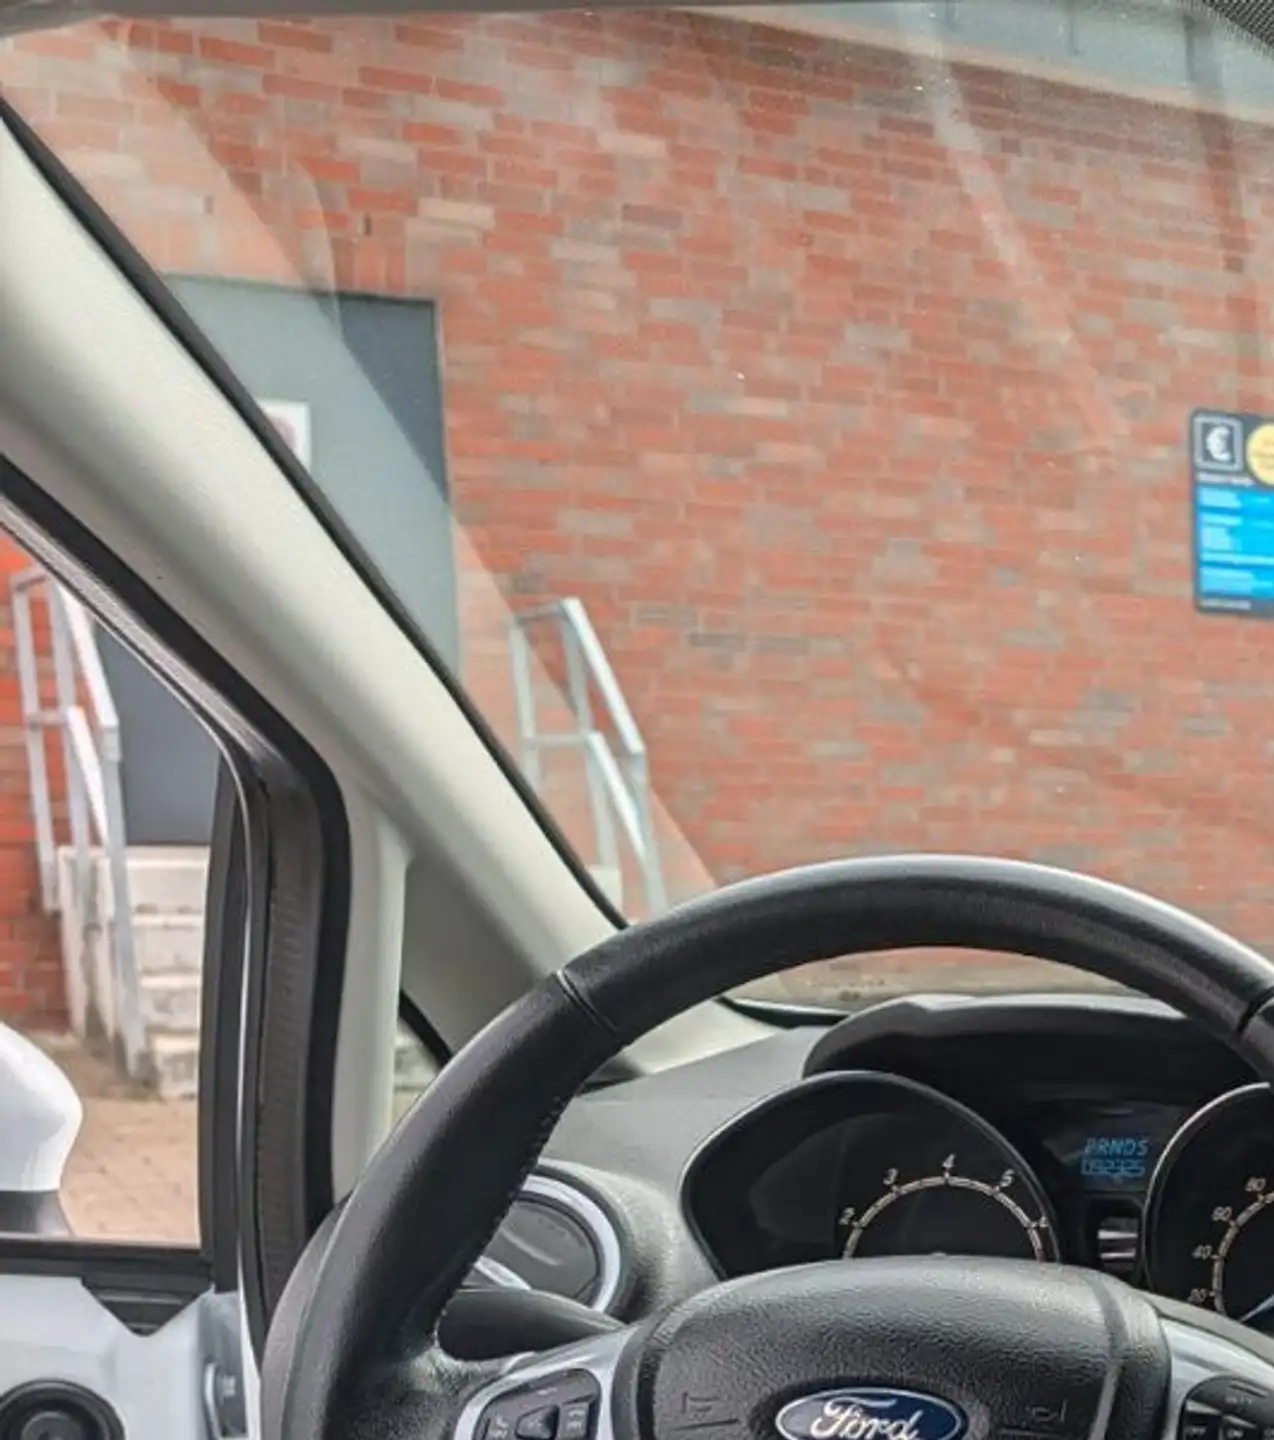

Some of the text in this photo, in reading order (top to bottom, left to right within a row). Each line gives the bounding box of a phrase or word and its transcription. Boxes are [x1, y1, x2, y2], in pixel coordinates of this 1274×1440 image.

[883, 1168, 899, 1185] 3
[941, 1153, 956, 1169] 4
[1000, 1168, 1015, 1187] 5
